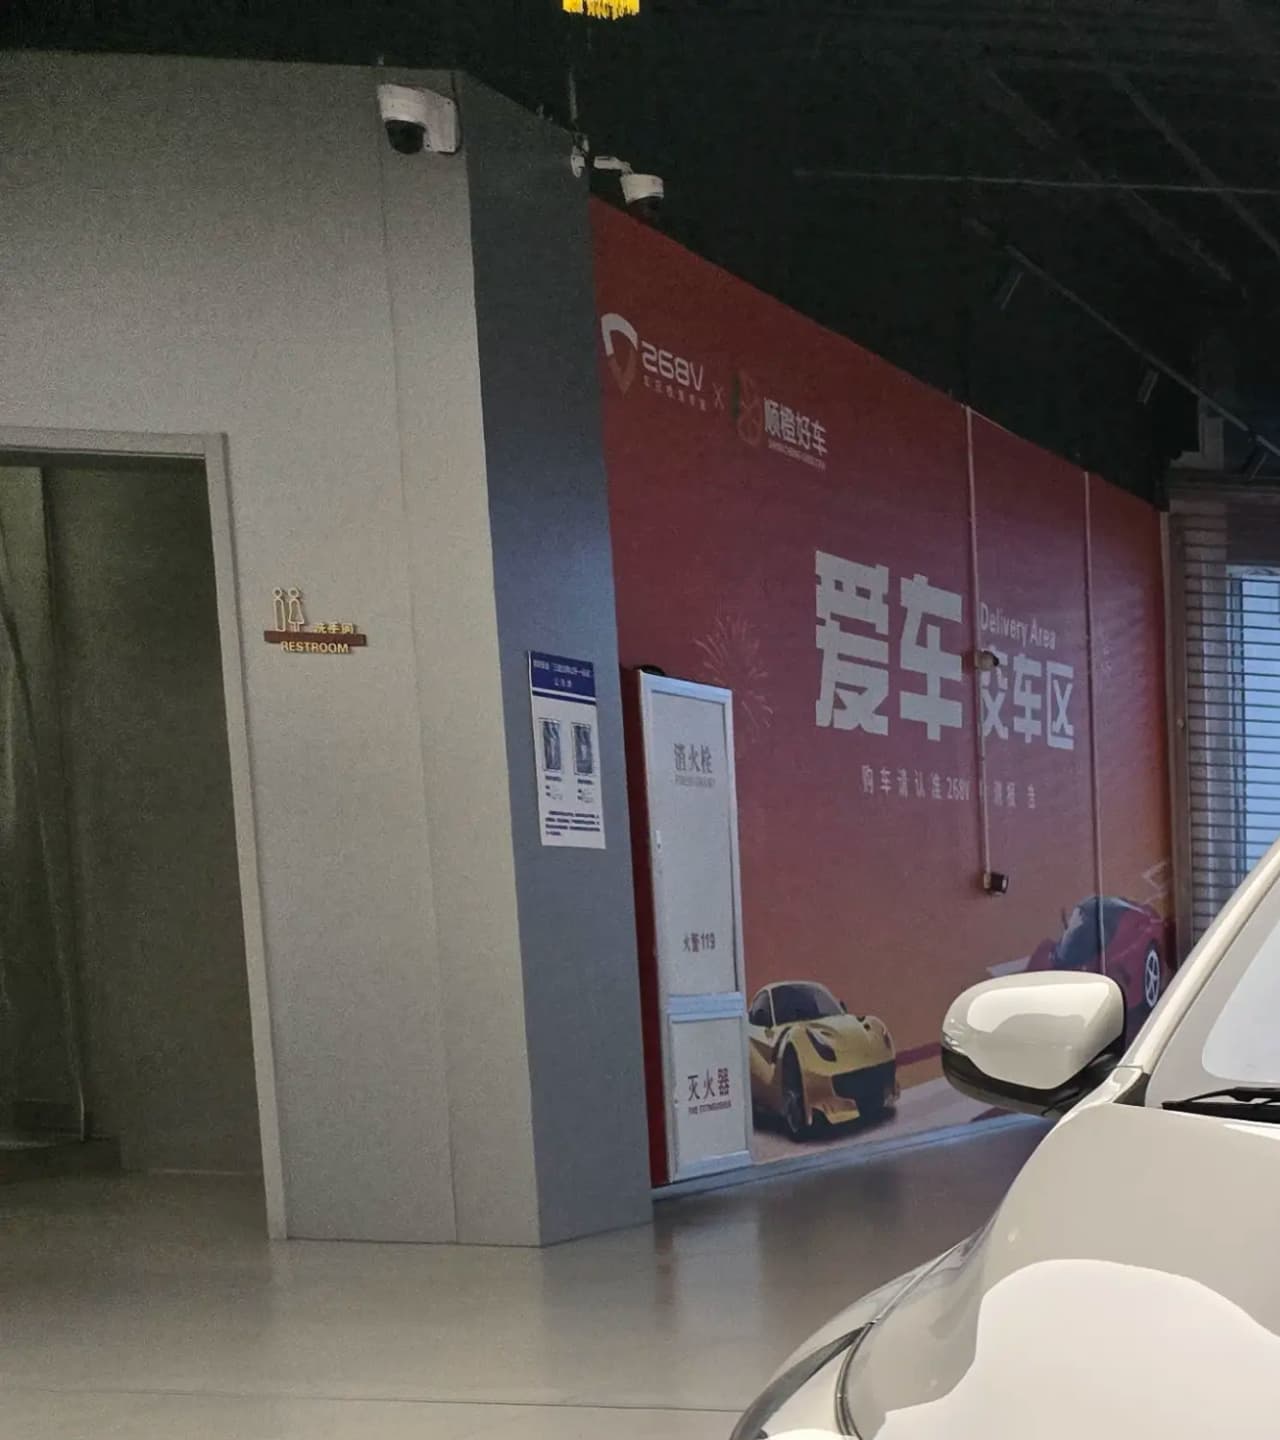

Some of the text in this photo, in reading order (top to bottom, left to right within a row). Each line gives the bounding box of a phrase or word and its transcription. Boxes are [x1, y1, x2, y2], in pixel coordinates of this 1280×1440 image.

[641, 340, 703, 391] 268V
[764, 398, 828, 456] 顺橙好车
[280, 640, 349, 653] RESTROOM
[815, 550, 1074, 750] 爱车 交车区
[981, 601, 1056, 650] Delivery Area
[687, 1067, 729, 1101] 灭火器
